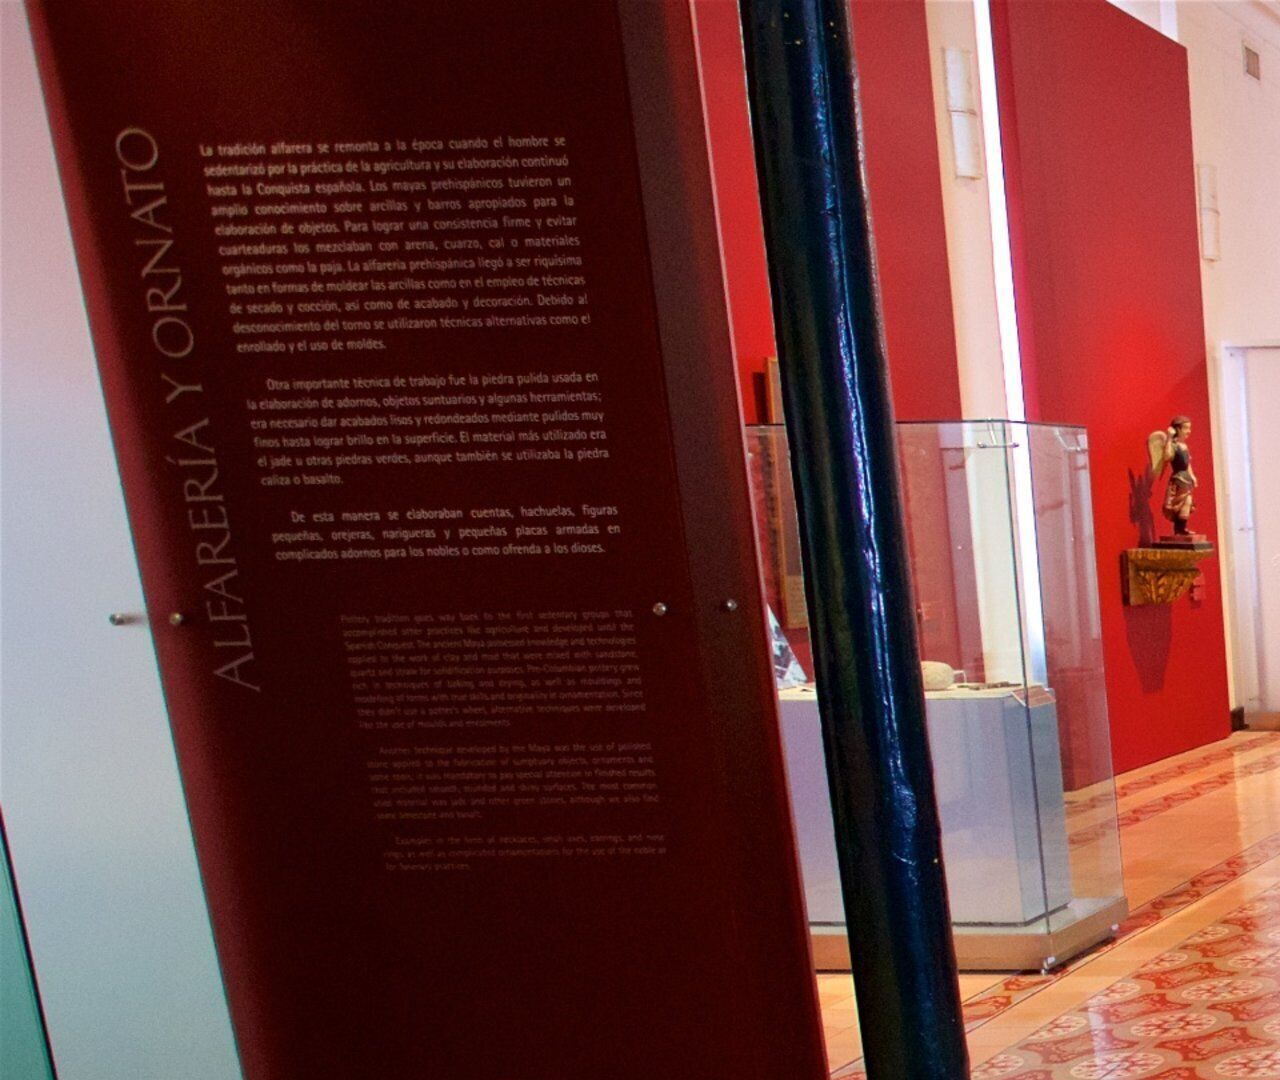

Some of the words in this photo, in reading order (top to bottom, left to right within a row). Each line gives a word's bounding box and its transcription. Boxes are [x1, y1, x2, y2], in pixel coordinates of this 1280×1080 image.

[199, 143, 213, 155] La
[217, 142, 265, 154] tradición
[270, 141, 312, 153] alfarera
[317, 143, 329, 152] se
[334, 139, 379, 152] remonta
[396, 138, 406, 150] la
[412, 138, 444, 153] época
[448, 136, 488, 149] cuando
[493, 136, 503, 148] el
[508, 135, 548, 147] hombre
[554, 137, 565, 146] se
[206, 183, 237, 195] hasta
[241, 182, 252, 194] la
[256, 181, 310, 197] Conquista
[315, 180, 364, 196] española.
[369, 179, 387, 191] Los
[392, 180, 426, 194] mayas
[430, 176, 503, 193] prehispánicos
[508, 175, 552, 188] tuvieron
[557, 177, 571, 187] un
[211, 203, 248, 218] amplio
[254, 201, 327, 214] conocimiento
[333, 200, 362, 212] sobre
[369, 199, 407, 211] arcillas
[427, 198, 461, 210] barros
[468, 196, 527, 212] apropiados
[533, 198, 557, 210] para
[564, 195, 574, 206] la
[114, 127, 194, 358] ORNATO
[218, 241, 287, 254] cuarteaduras
[293, 241, 309, 252] los
[315, 239, 372, 252] mezclaban
[379, 241, 398, 250] con
[405, 240, 438, 250] arena,
[444, 239, 482, 249] cuarzo,
[488, 236, 504, 248] cal
[524, 235, 580, 247] materiales
[236, 339, 285, 351] enrollado
[296, 339, 307, 350] el
[310, 341, 328, 350] uso
[331, 338, 343, 350] de
[346, 338, 385, 350] moldes.
[166, 373, 203, 405] Y
[266, 378, 289, 389] Otra
[292, 376, 350, 392] importante
[352, 375, 390, 387] técnica
[393, 375, 406, 386] de
[409, 374, 446, 389] trabajo
[448, 374, 466, 385] fue
[469, 374, 478, 385] la
[481, 373, 514, 388] piedra
[517, 372, 549, 387] pulida
[552, 371, 582, 383] usada
[585, 373, 598, 382] en
[260, 473, 290, 485] caliza
[302, 472, 342, 484] basalto.
[290, 510, 304, 521] De
[312, 509, 334, 521] esta
[342, 511, 380, 520] manera
[388, 510, 398, 519] se
[406, 507, 463, 519] elaboraban
[470, 506, 513, 518] cuentas,
[520, 505, 574, 517] hachuelas,
[582, 504, 618, 519] figuras
[165, 417, 260, 693] ALFARERÍA
[275, 547, 338, 562] complicados
[340, 546, 381, 557] adornos
[384, 548, 407, 560] para
[409, 545, 424, 556] los
[426, 544, 459, 556] nobles
[472, 546, 500, 555] como
[502, 543, 541, 554] ofrenda
[553, 542, 568, 553] los
[570, 542, 604, 553] dioses.
